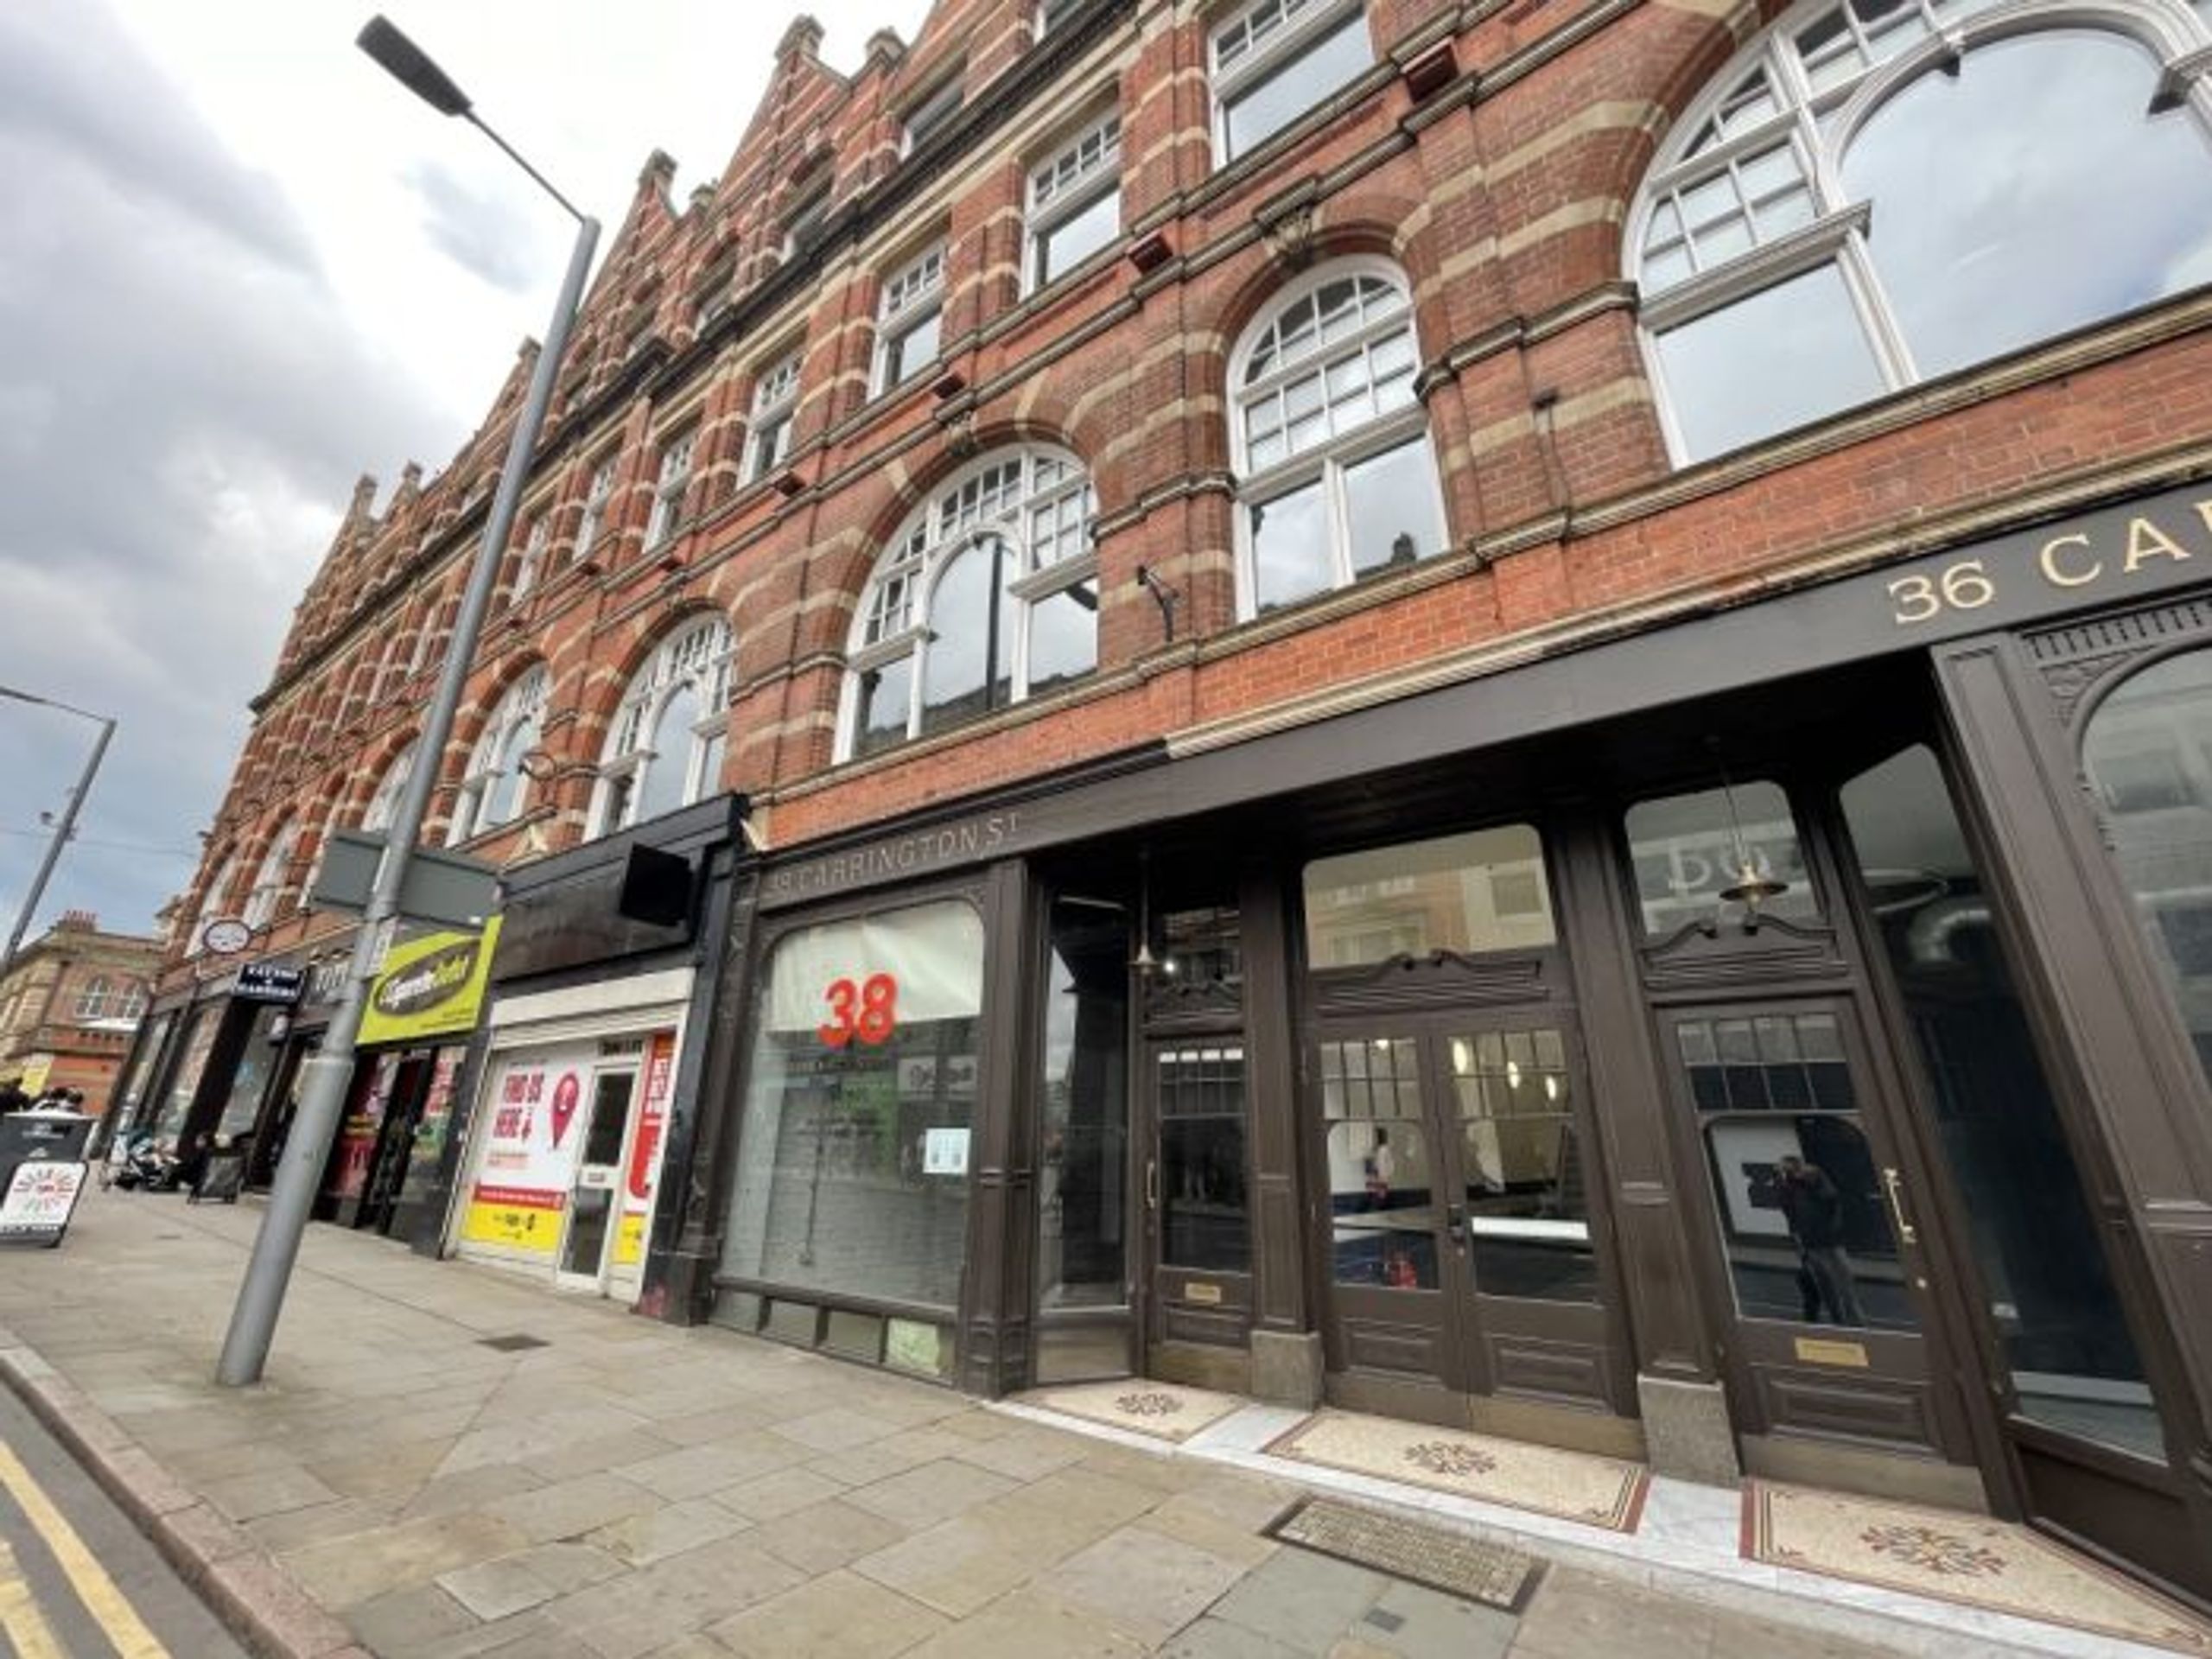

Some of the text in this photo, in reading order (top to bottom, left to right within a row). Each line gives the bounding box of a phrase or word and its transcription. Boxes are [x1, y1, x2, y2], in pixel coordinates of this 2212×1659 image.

[1887, 499, 2212, 624] 36 CA
[817, 973, 898, 1051] 38
